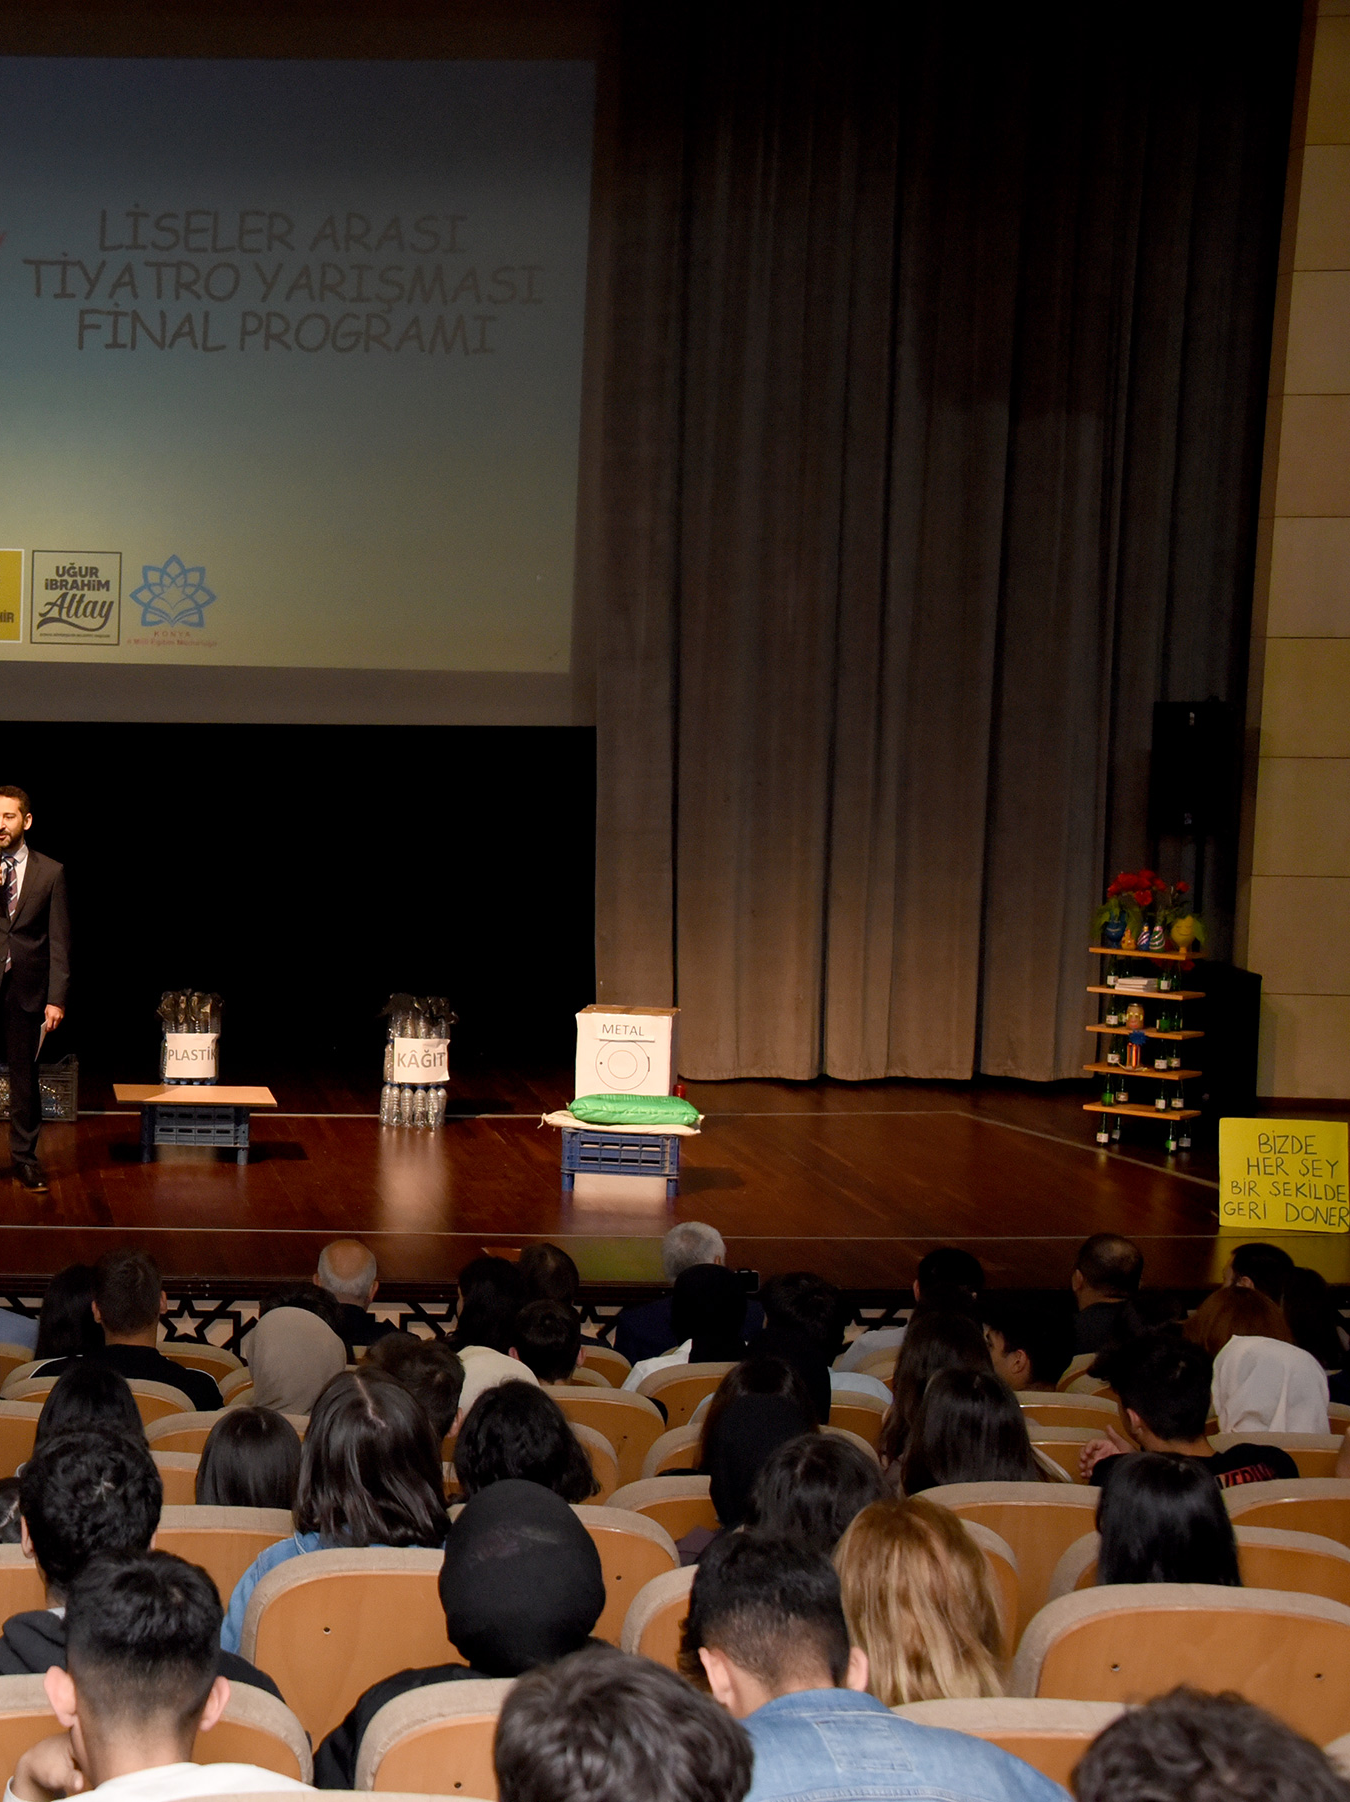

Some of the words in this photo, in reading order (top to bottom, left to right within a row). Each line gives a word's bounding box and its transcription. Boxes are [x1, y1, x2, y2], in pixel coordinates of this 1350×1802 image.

[98, 203, 296, 253] LİSELER
[308, 213, 467, 254] ARASI
[22, 251, 240, 299] TİYATRO
[255, 262, 545, 313] YARIŞMASI
[77, 302, 226, 350] FİNAL
[238, 312, 499, 355] PROGRAMI
[55, 562, 99, 579] UĞUR
[37, 591, 114, 632] Altay
[602, 1023, 645, 1037] METAL
[1247, 1157, 1289, 1176] HER
